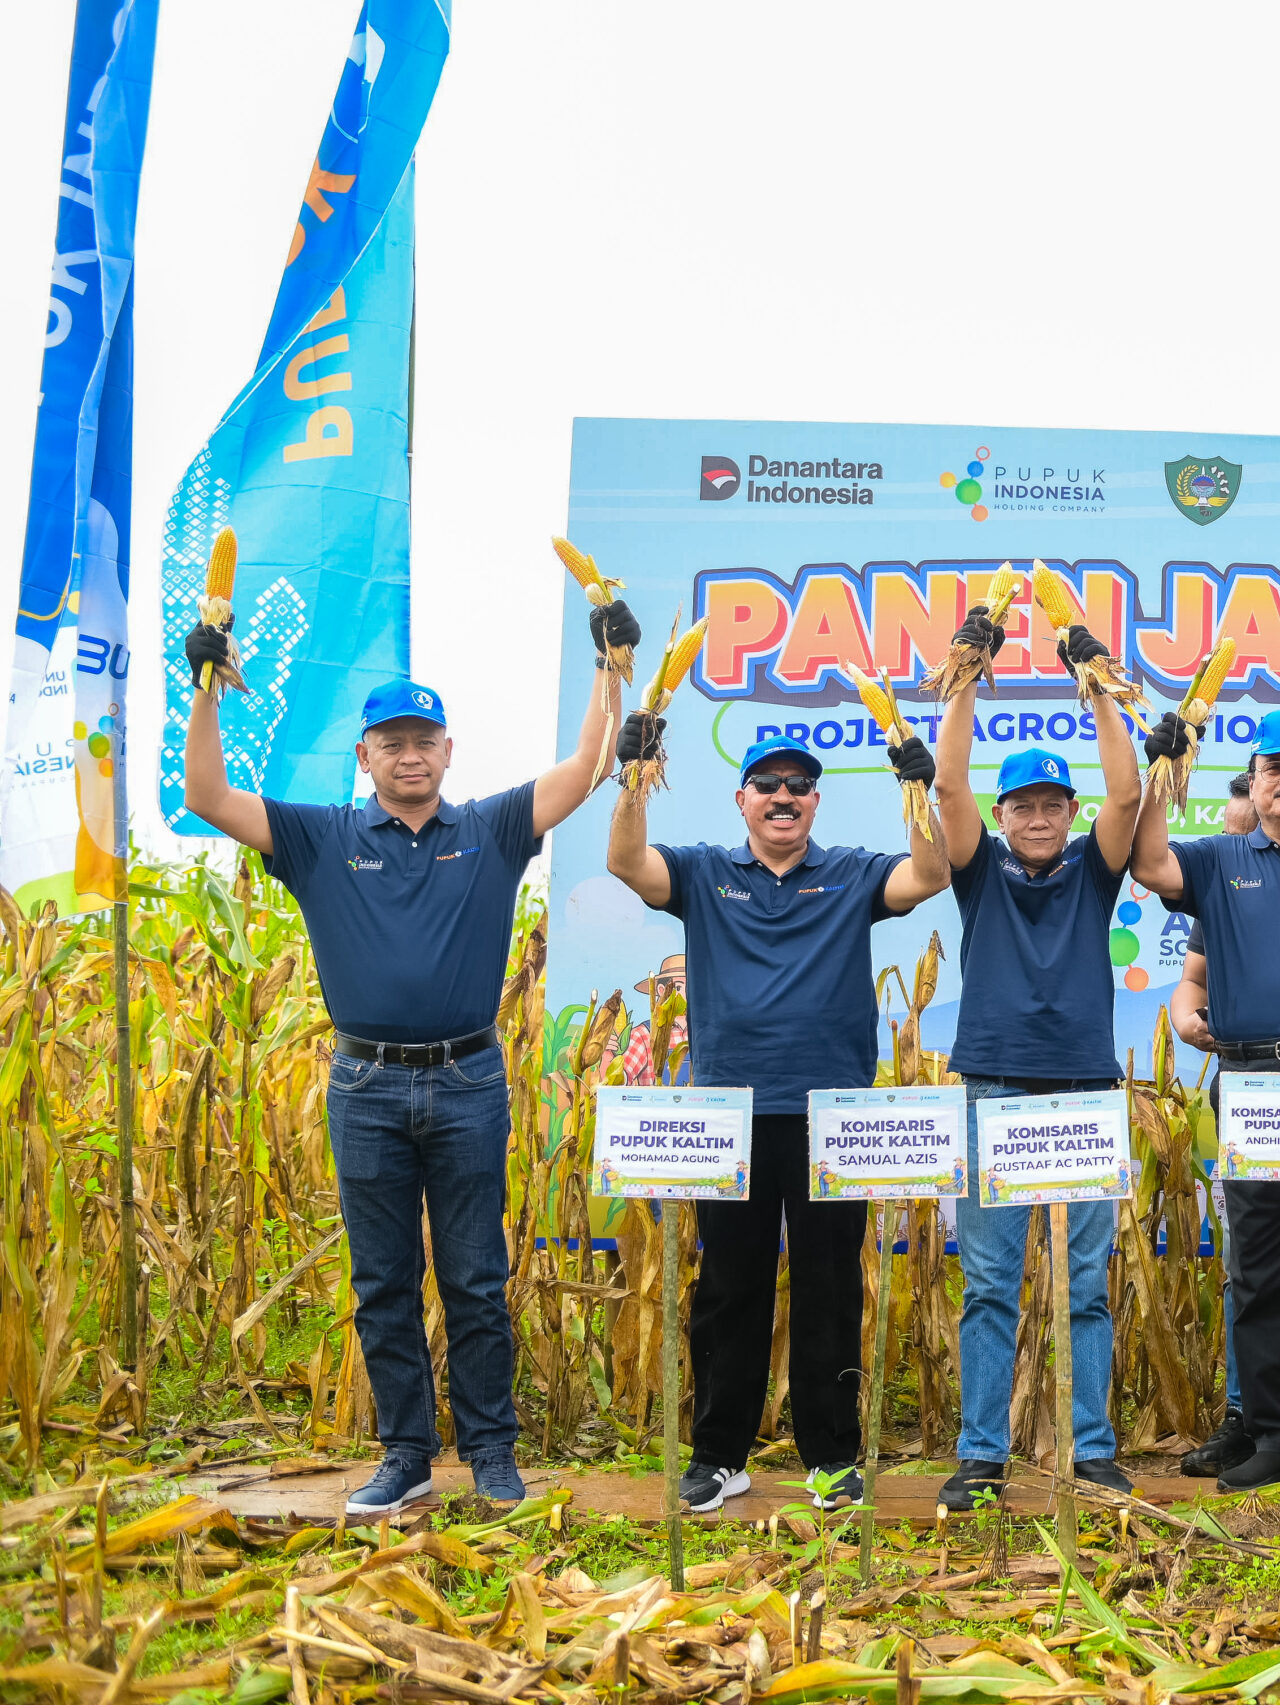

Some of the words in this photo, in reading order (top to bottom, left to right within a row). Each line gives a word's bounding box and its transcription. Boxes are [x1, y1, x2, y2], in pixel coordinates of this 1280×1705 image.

[748, 455, 883, 480] Danantara
[995, 467, 1107, 484] PUPUK
[747, 480, 874, 506] Indonesia
[994, 484, 1105, 501] INDONESIA
[994, 503, 1043, 512] HOLDING
[1052, 504, 1107, 513] COMPANY
[640, 1120, 705, 1132] DIREKSI
[841, 1120, 934, 1132] KOMISARIS
[1008, 1123, 1098, 1139] KOMISARIS
[610, 1136, 667, 1148] PUPUK
[672, 1137, 734, 1149] KALTIM
[826, 1136, 883, 1148] PUPUK
[889, 1135, 950, 1147] KALTIM
[993, 1143, 1049, 1155] PUPUK
[1055, 1138, 1113, 1151] KALTIM
[621, 1154, 678, 1162] MOHAMAD
[839, 1155, 900, 1165] SAMUAL
[905, 1154, 937, 1164] AZIS
[994, 1160, 1051, 1172] GUSTAAF
[1055, 1158, 1072, 1167] AC
[1076, 1156, 1114, 1166] PATTY
